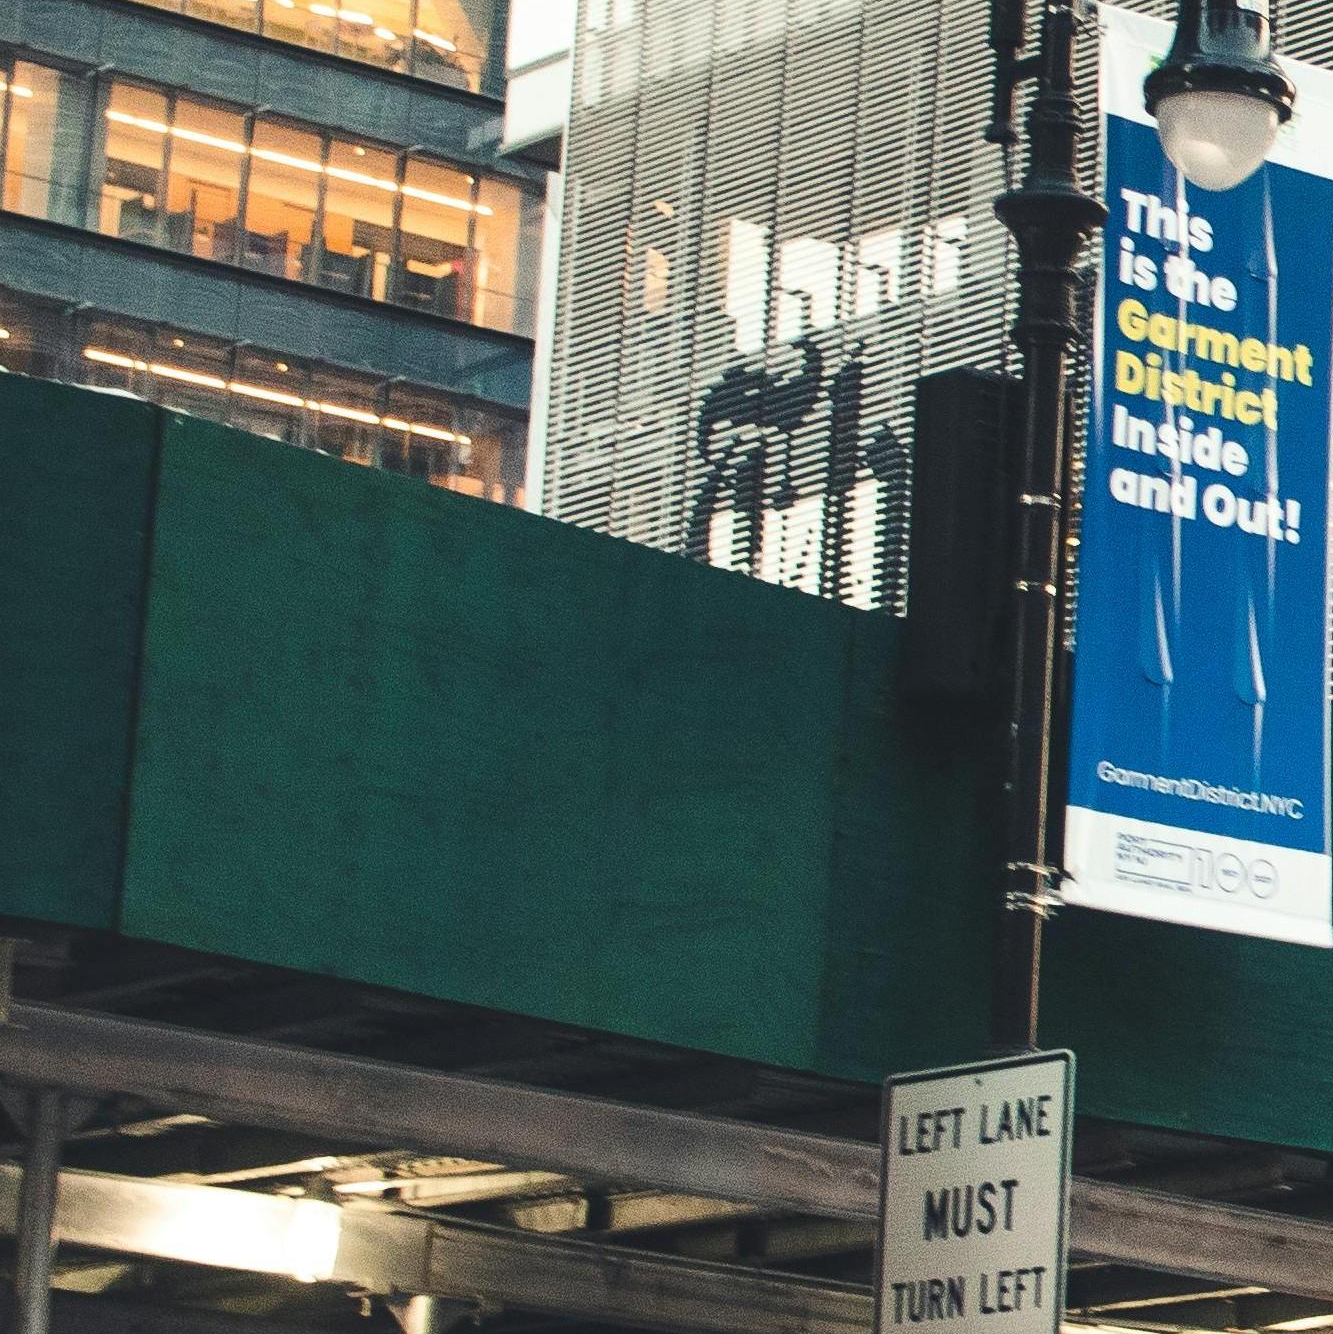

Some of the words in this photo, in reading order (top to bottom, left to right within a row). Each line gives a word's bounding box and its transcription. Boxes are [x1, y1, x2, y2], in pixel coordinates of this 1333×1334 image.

[1121, 188, 1214, 253] This
[1119, 237, 1158, 291] is
[1164, 253, 1238, 312] the
[1116, 298, 1313, 387] Garment
[1114, 349, 1278, 431] District
[1112, 404, 1249, 476] Inside
[1109, 466, 1197, 520] and
[1202, 483, 1301, 545] Out!
[899, 1107, 966, 1155] LEFT
[980, 1095, 1052, 1144] LANE
[922, 1178, 1019, 1242] MUST
[890, 1274, 966, 1324] TURN
[980, 1265, 1046, 1315] LEFT
